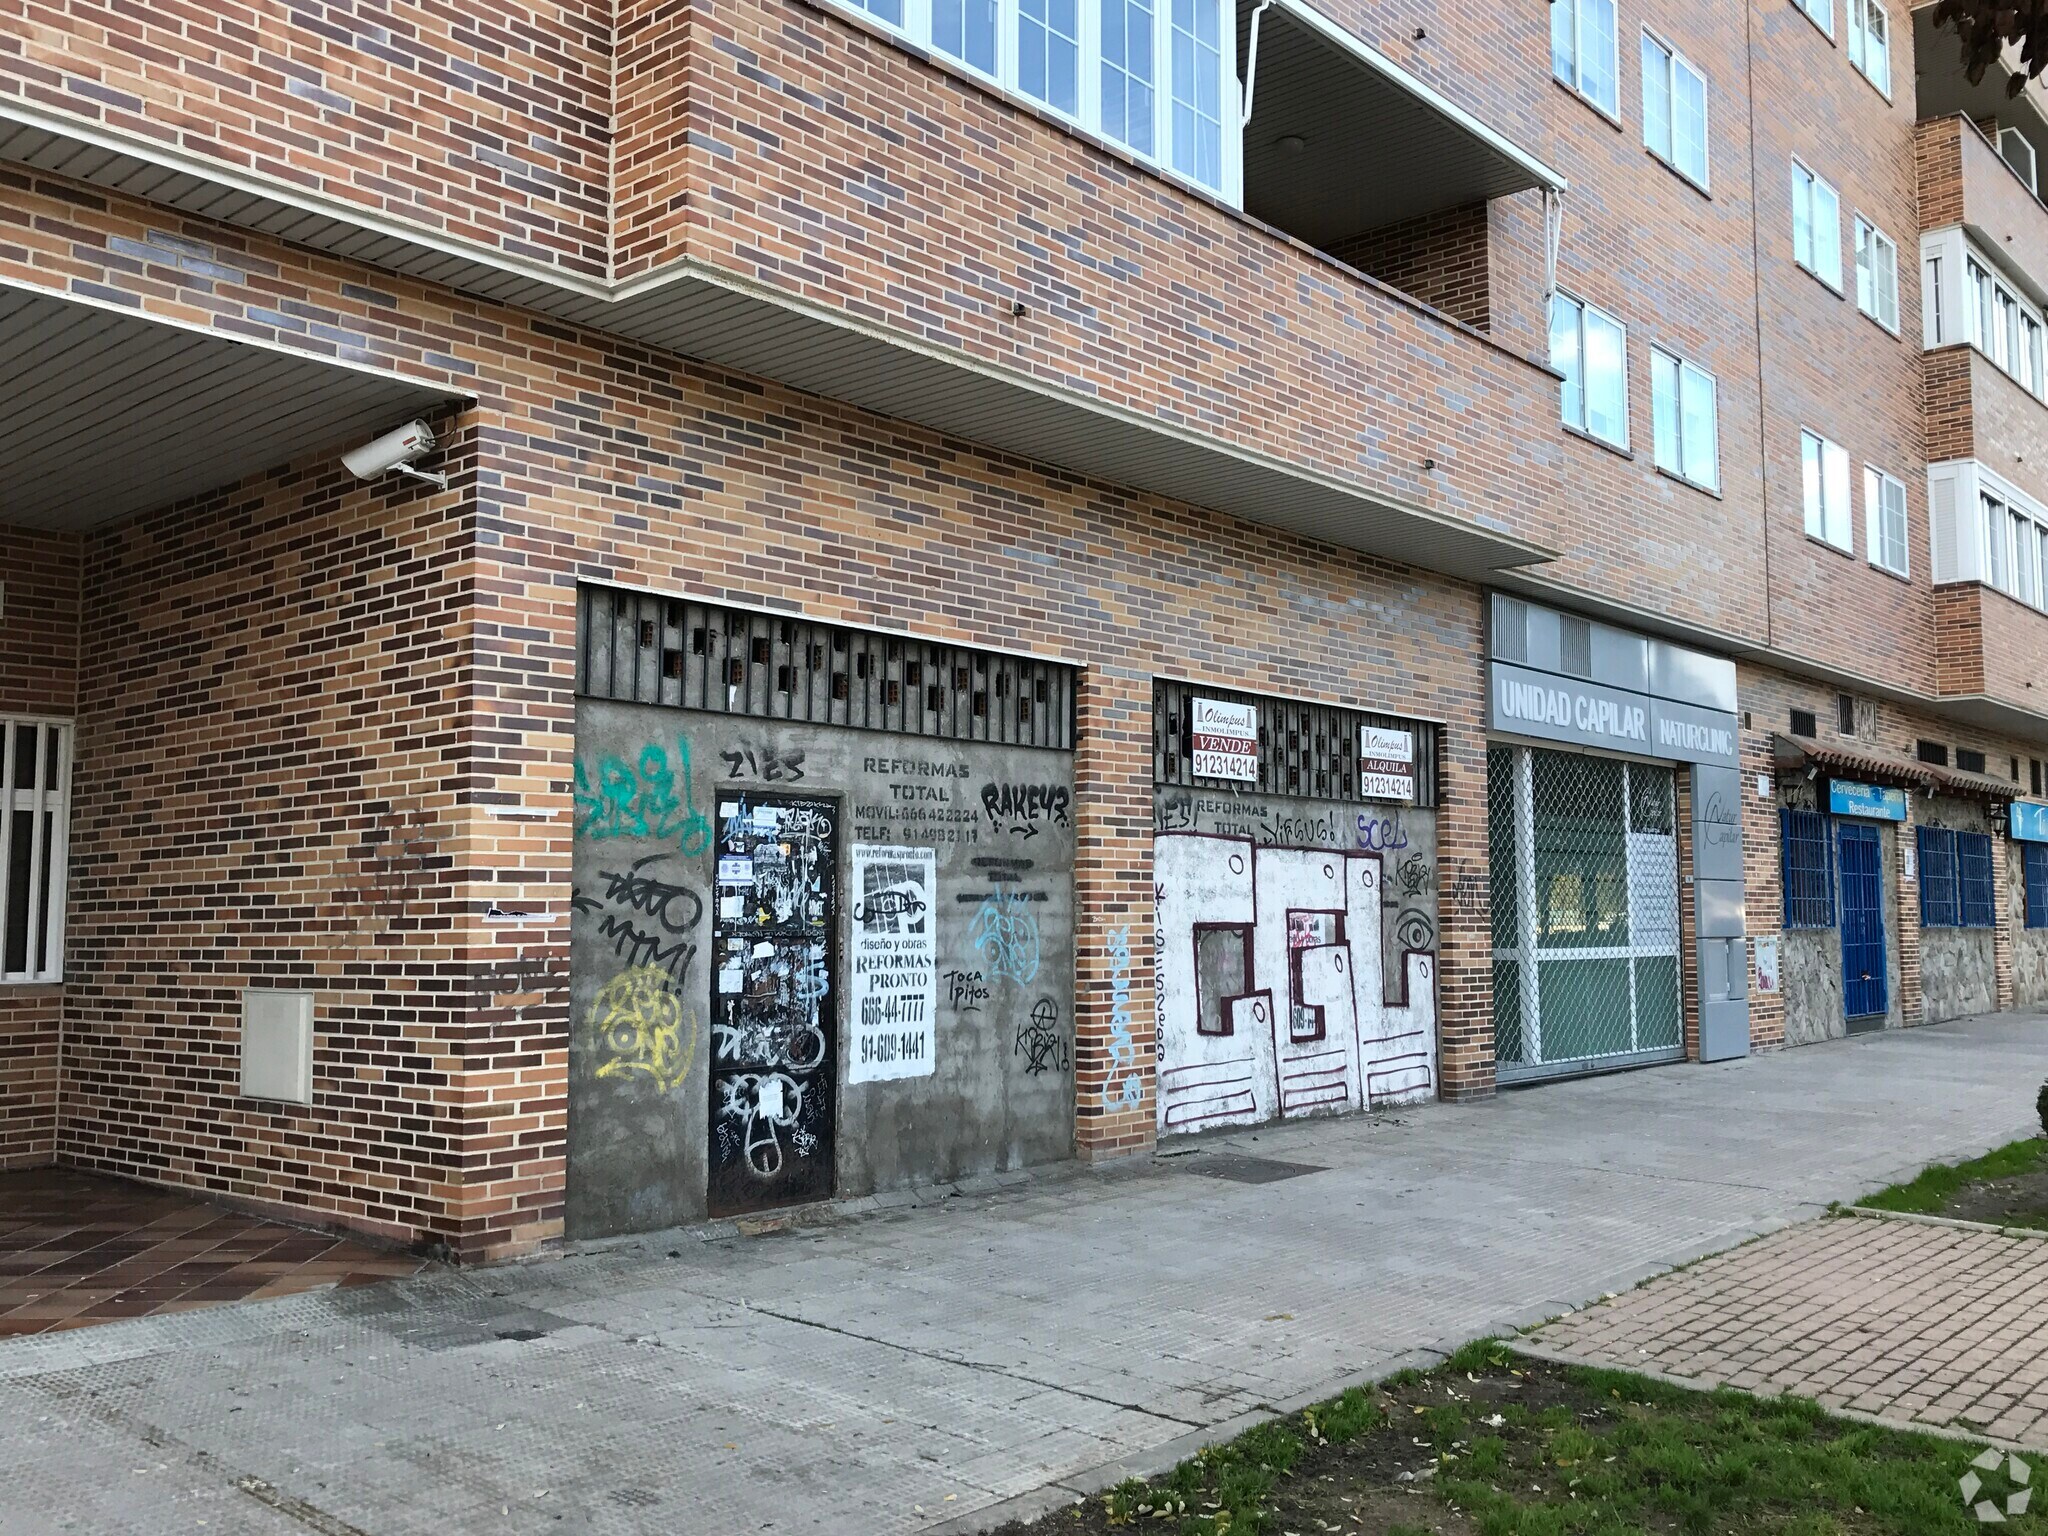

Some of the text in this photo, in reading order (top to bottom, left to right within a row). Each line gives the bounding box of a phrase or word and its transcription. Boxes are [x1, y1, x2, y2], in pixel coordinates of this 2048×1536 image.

[1204, 706, 1246, 730] Olimpus
[1501, 679, 1733, 756] UNIDAD CAPILAR NATURCLINIC
[1201, 725, 1249, 737] INMOLIMPUS
[1199, 735, 1252, 755] VENDE
[1370, 733, 1405, 753] Olimpus
[1368, 750, 1407, 760] INMOLIMPUS
[863, 757, 970, 779] REFORMAS
[1194, 754, 1256, 778] 912314214
[1366, 759, 1408, 774] ALQUILA
[889, 783, 950, 803] TOTAL
[1363, 775, 1412, 797] 912314214
[1196, 799, 1268, 818] REFORMAS
[1848, 800, 1891, 818] Restaurante
[855, 826, 891, 842] TELF:
[1214, 820, 1255, 835] TOTAL
[855, 847, 934, 861] www.reformaspronto.com
[860, 937, 928, 952] diseño y obras
[855, 952, 932, 974] REFORMAS
[869, 971, 928, 993] PRONTO
[860, 993, 925, 1026] 666-44-7777
[860, 1031, 925, 1064] 91-609-1441
